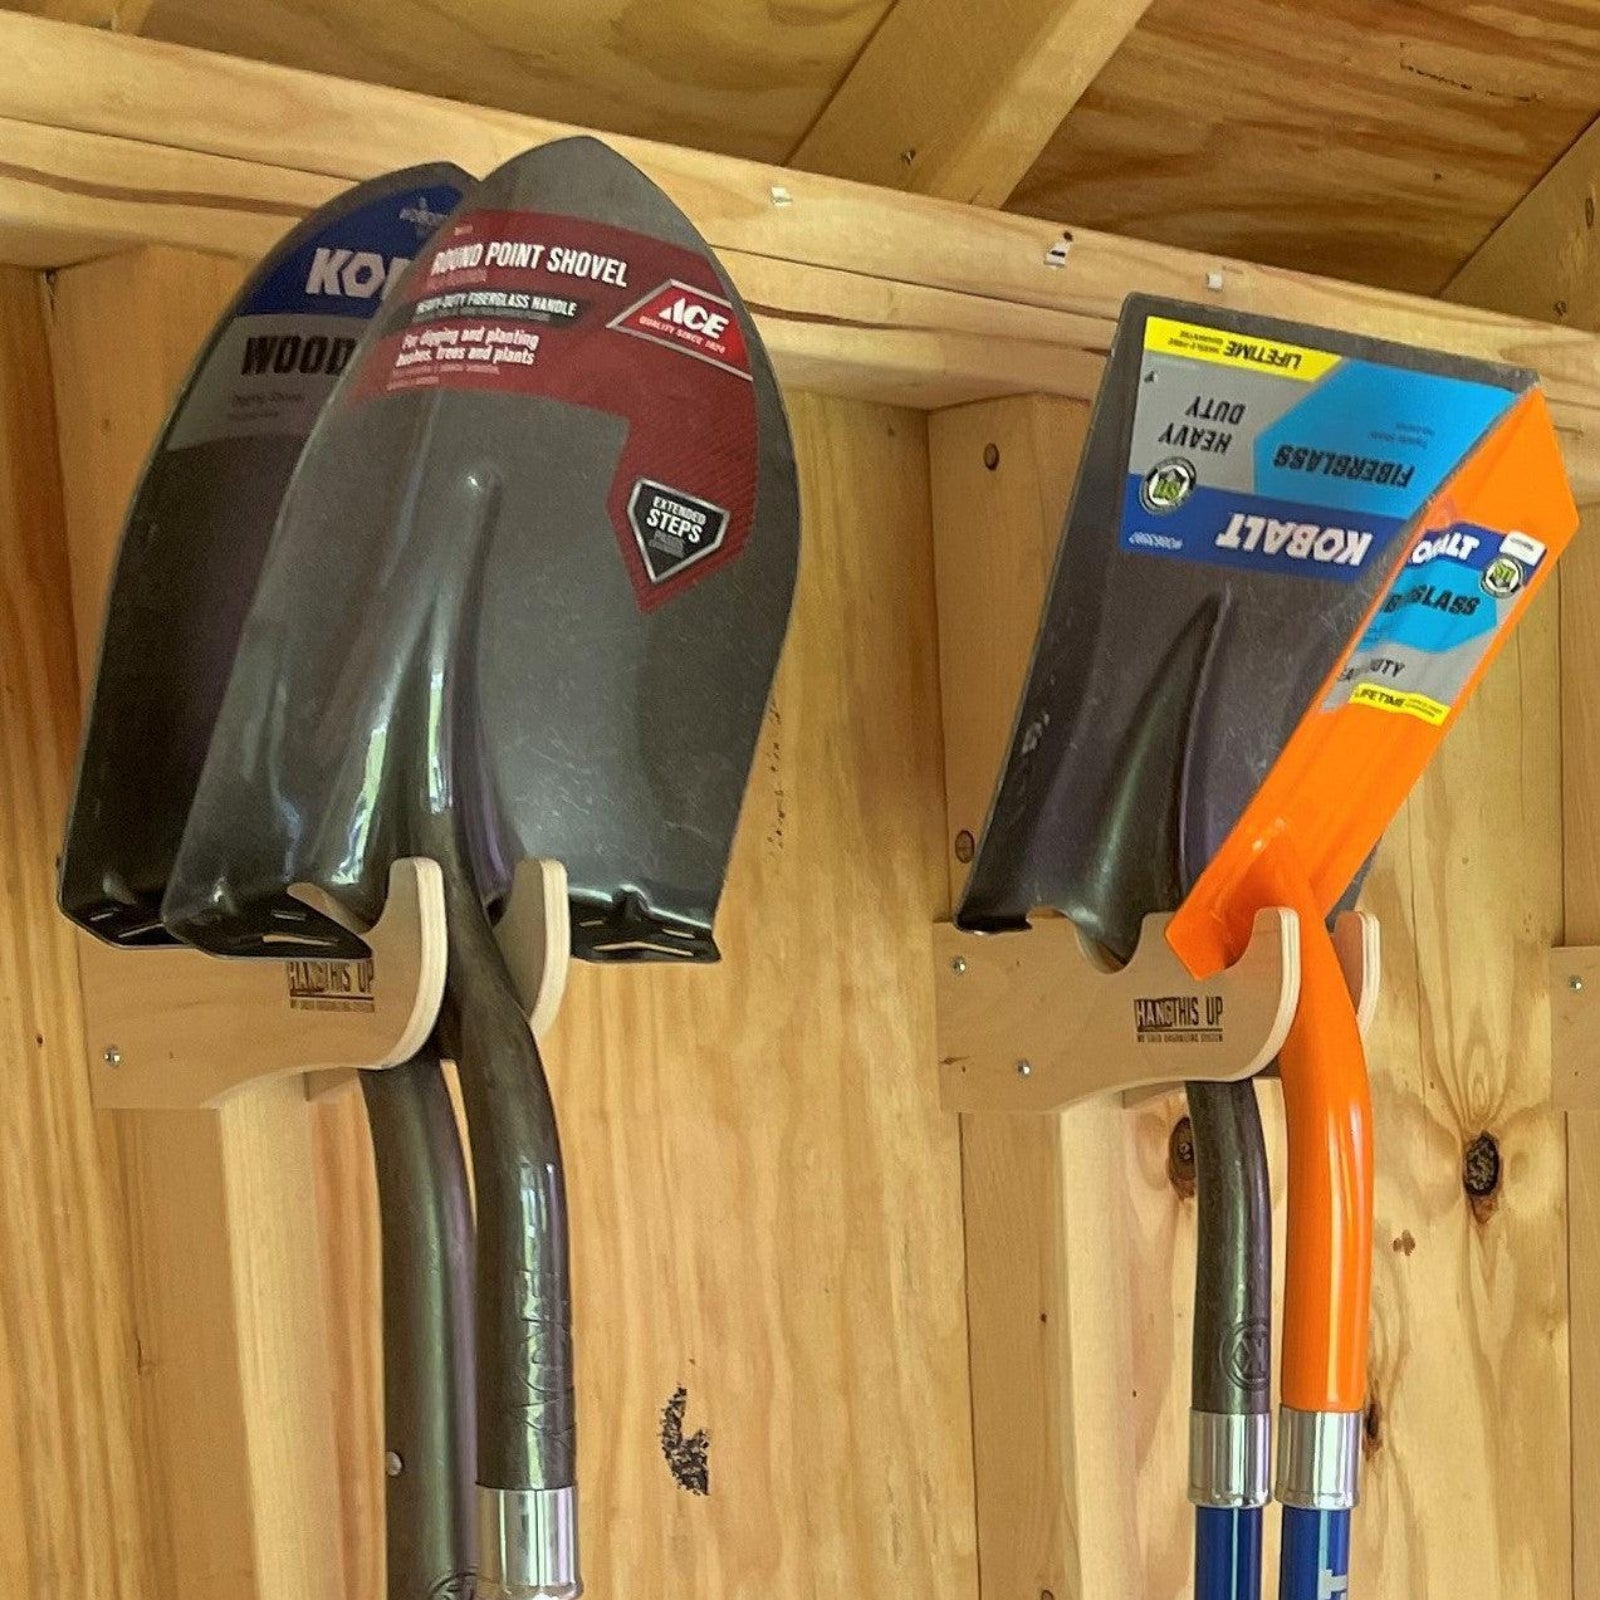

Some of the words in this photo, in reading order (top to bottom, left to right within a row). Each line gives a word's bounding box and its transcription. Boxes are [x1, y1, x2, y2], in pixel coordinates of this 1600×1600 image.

[430, 243, 484, 276] ROUND
[485, 241, 545, 270] POINT
[546, 247, 628, 288] SHOVEL
[467, 291, 530, 309] FIBERGLASS
[531, 295, 577, 318] HANDLE
[658, 297, 729, 340] ACE
[461, 325, 485, 342] and
[485, 326, 540, 351] planting
[436, 345, 465, 361] trees
[468, 344, 493, 361] and
[493, 346, 535, 366] plants
[1223, 339, 1302, 370] LIFETIME
[1185, 395, 1246, 425] DUTY
[1158, 422, 1232, 455] HEAVY
[1273, 443, 1416, 488] FIBERGLASS
[646, 508, 703, 543] STEPS
[652, 496, 707, 526] EXTENDED
[1215, 513, 1373, 566] KOBALT
[1206, 996, 1223, 1026] UP
